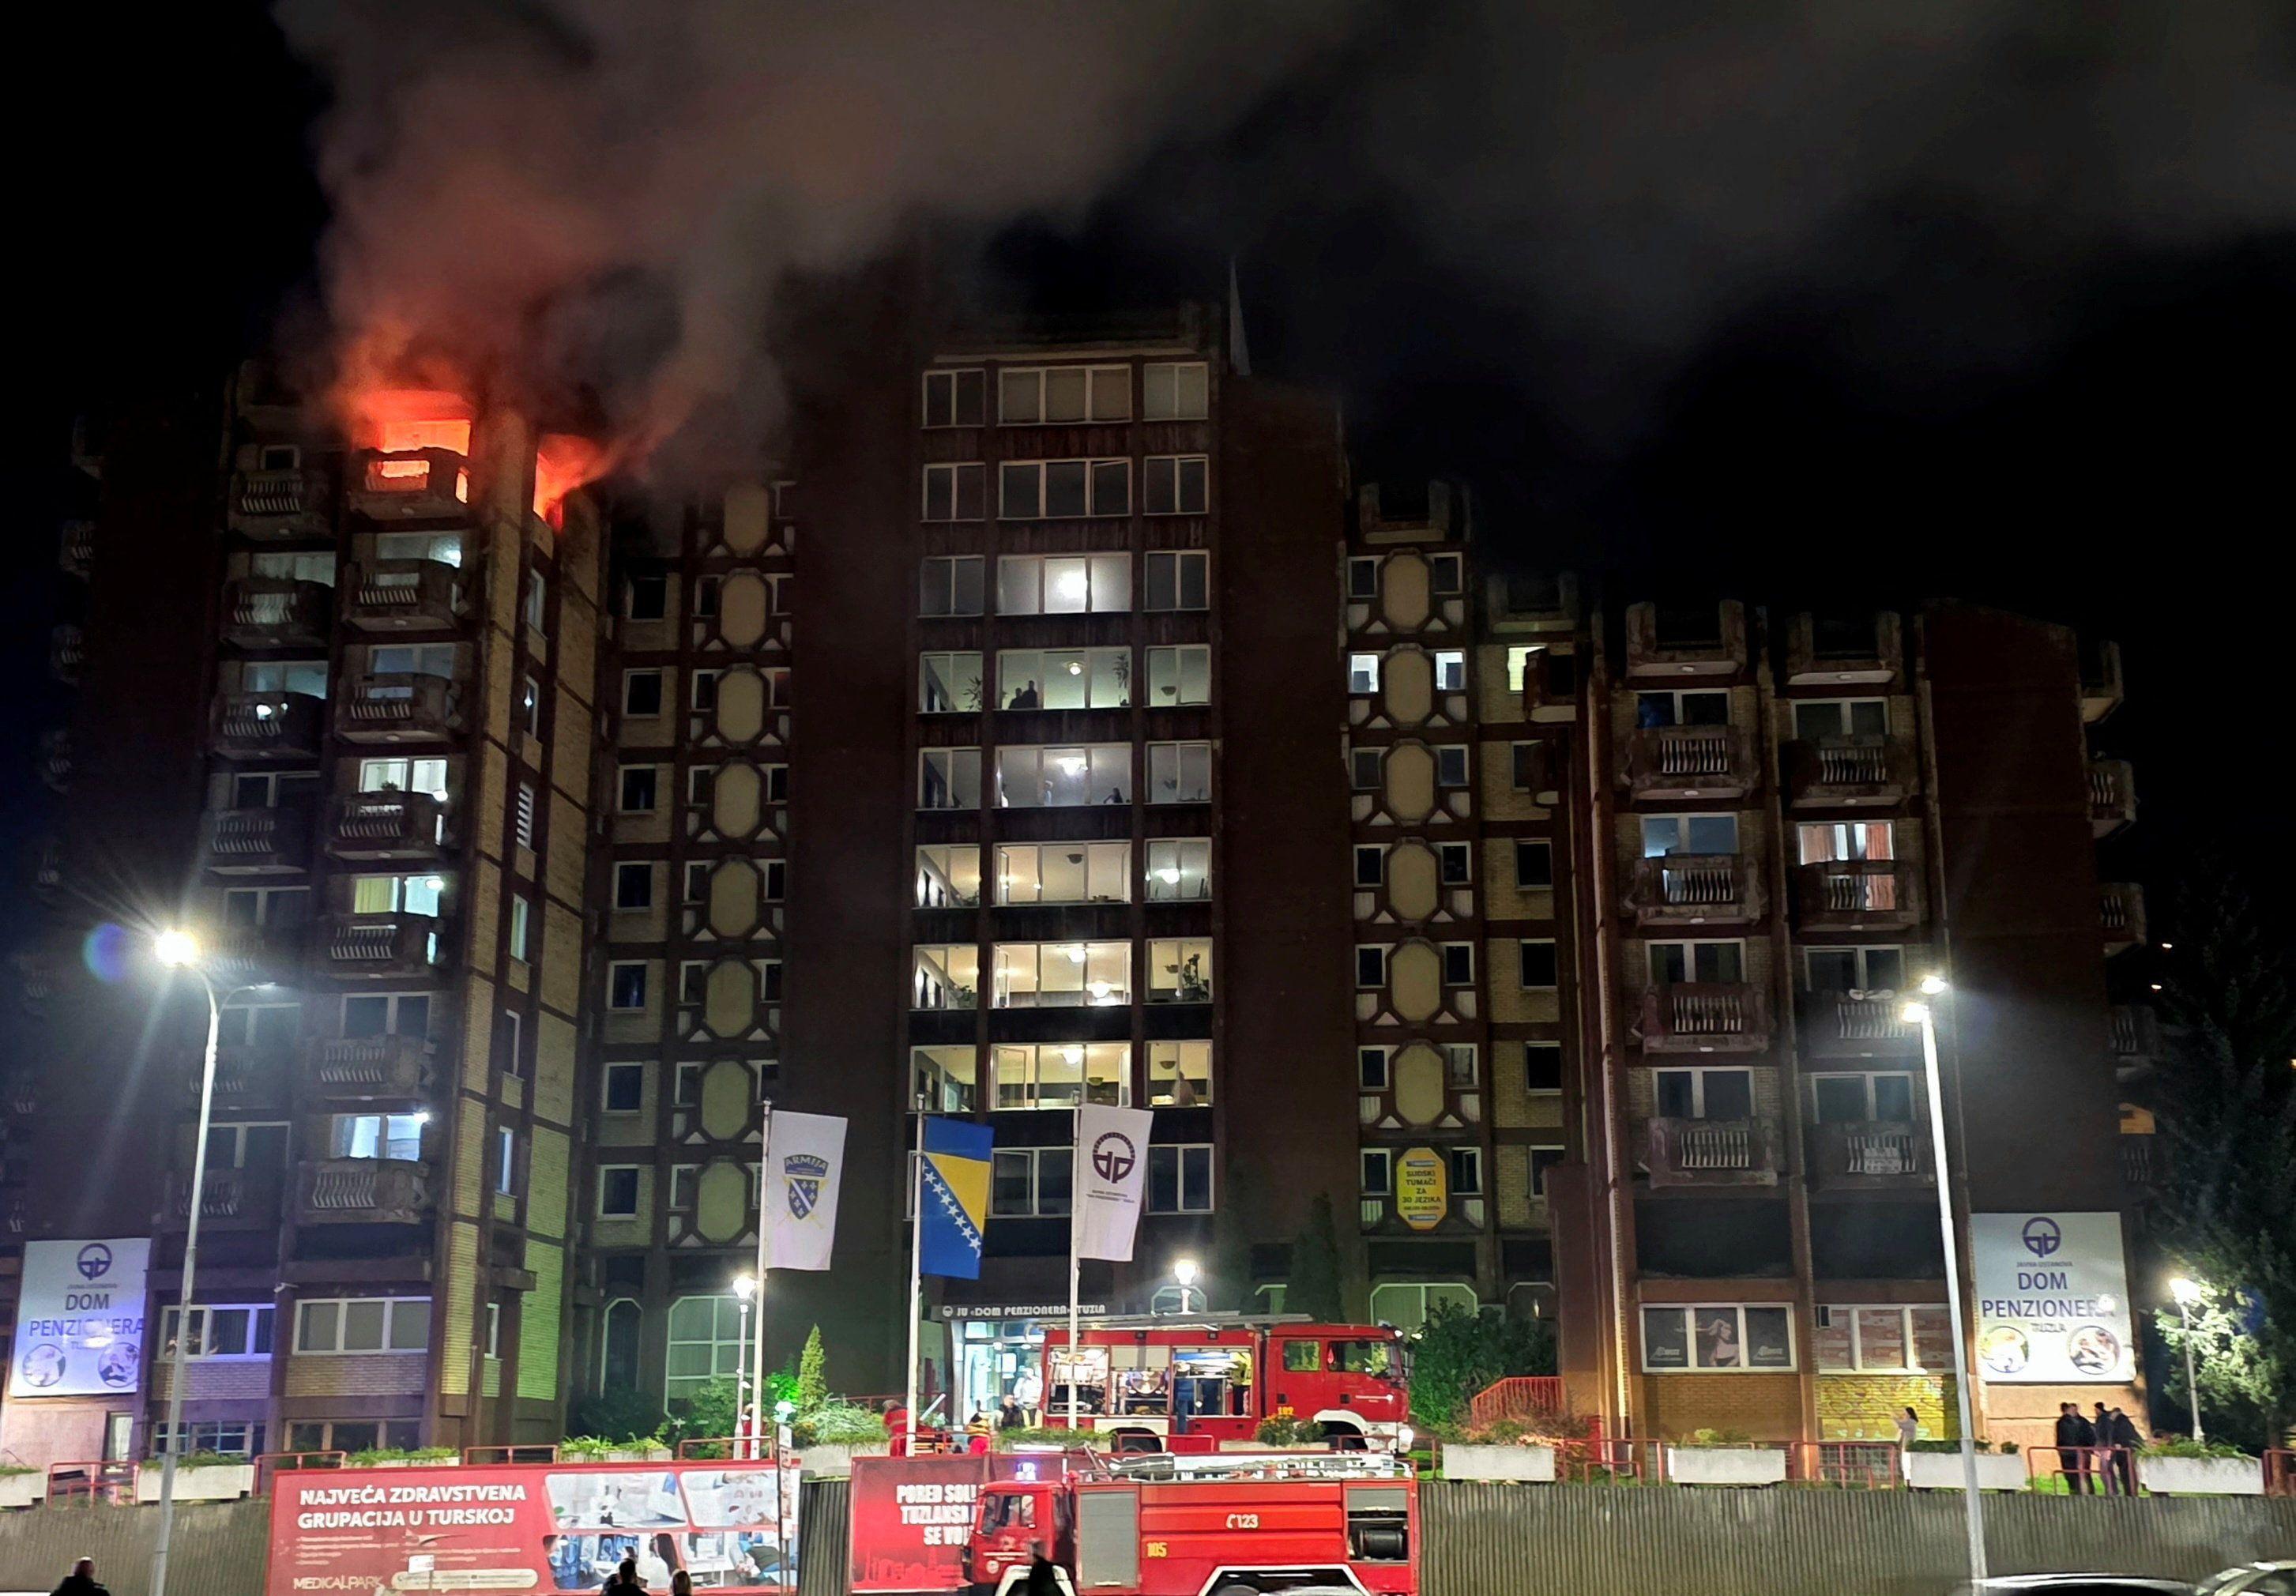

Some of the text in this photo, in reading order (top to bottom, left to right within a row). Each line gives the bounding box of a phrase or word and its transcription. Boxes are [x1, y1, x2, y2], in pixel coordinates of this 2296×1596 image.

[2018, 1272, 2068, 1290] DOM
[65, 1293, 110, 1311] DOM
[957, 1308, 968, 1316] JU
[29, 1318, 145, 1337] PENZIERA
[390, 1485, 527, 1504] ZDRAVSTVENA
[297, 1508, 515, 1529] GRUPACIJA U TURSKOJ
[1236, 1514, 1259, 1529] 123
[923, 1526, 942, 1545] SE
[1146, 1541, 1168, 1558] 105
